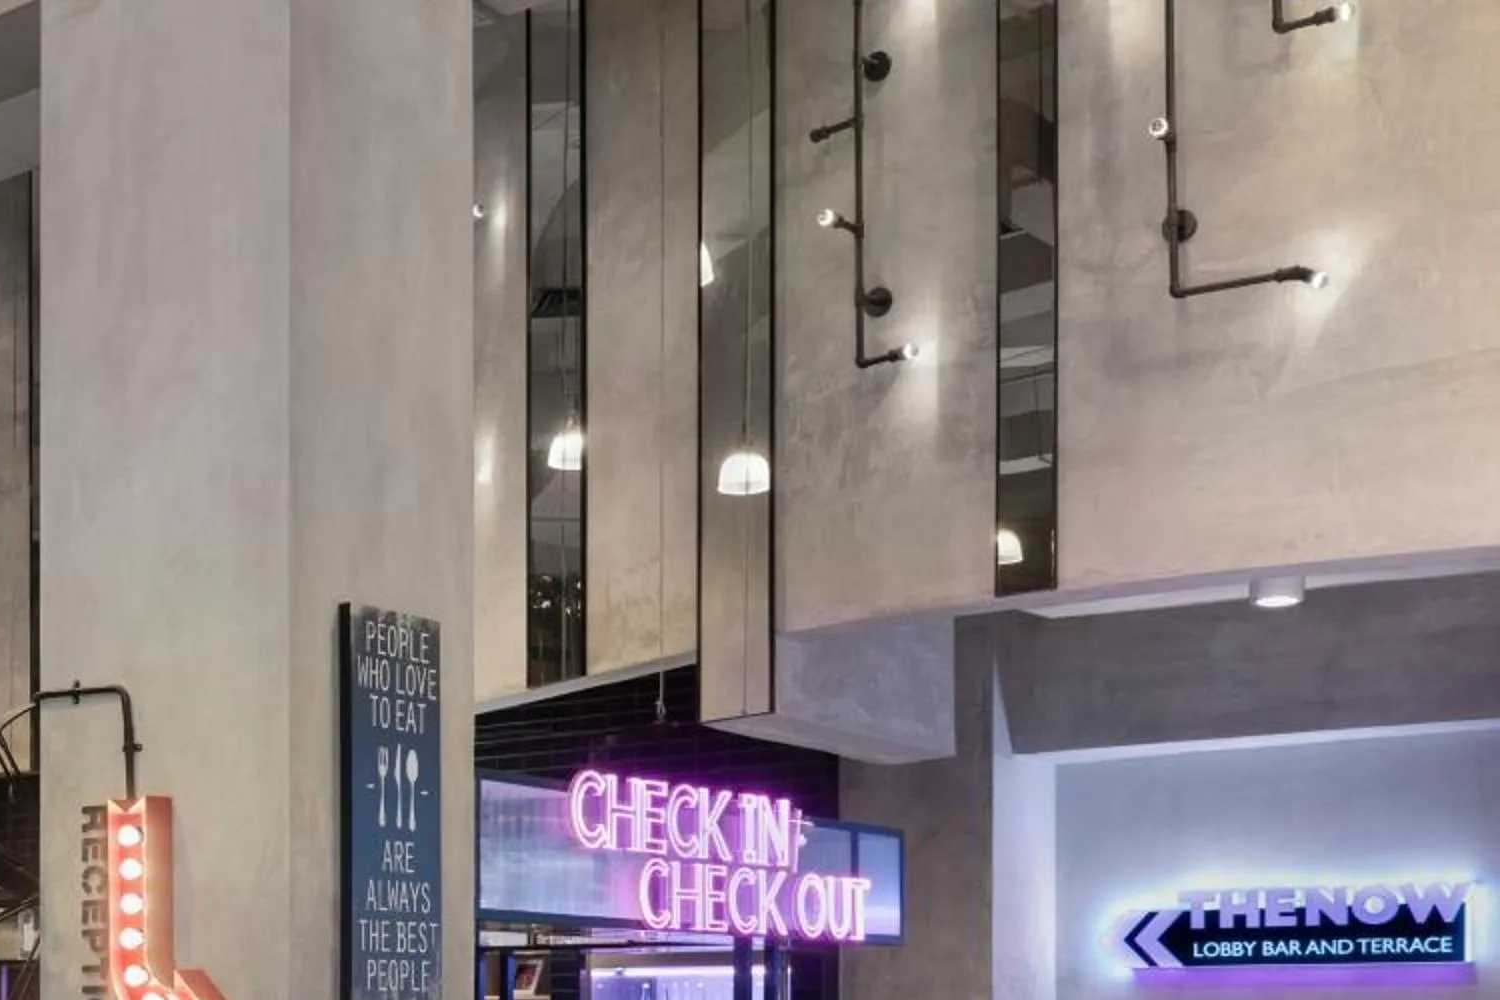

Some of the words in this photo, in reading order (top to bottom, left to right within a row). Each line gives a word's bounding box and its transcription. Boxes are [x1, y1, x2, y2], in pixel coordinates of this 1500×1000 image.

[365, 620, 430, 665] PEOPLE
[357, 654, 391, 692] WHO
[395, 661, 437, 701] LOVE
[369, 693, 392, 729] TO
[395, 699, 427, 734] EAT
[569, 769, 733, 863] CHECK
[381, 839, 416, 873] ARE
[365, 879, 431, 914] ALWAYS
[638, 857, 789, 937] CHECK
[797, 872, 871, 942] OUT
[357, 919, 391, 953] THE
[396, 921, 439, 953] BEST
[1192, 940, 1257, 958] LOBBY
[1261, 939, 1302, 957] BAR
[1301, 937, 1355, 956] AND
[1356, 935, 1453, 955] TERRACE
[366, 959, 431, 994] PEOPLE
